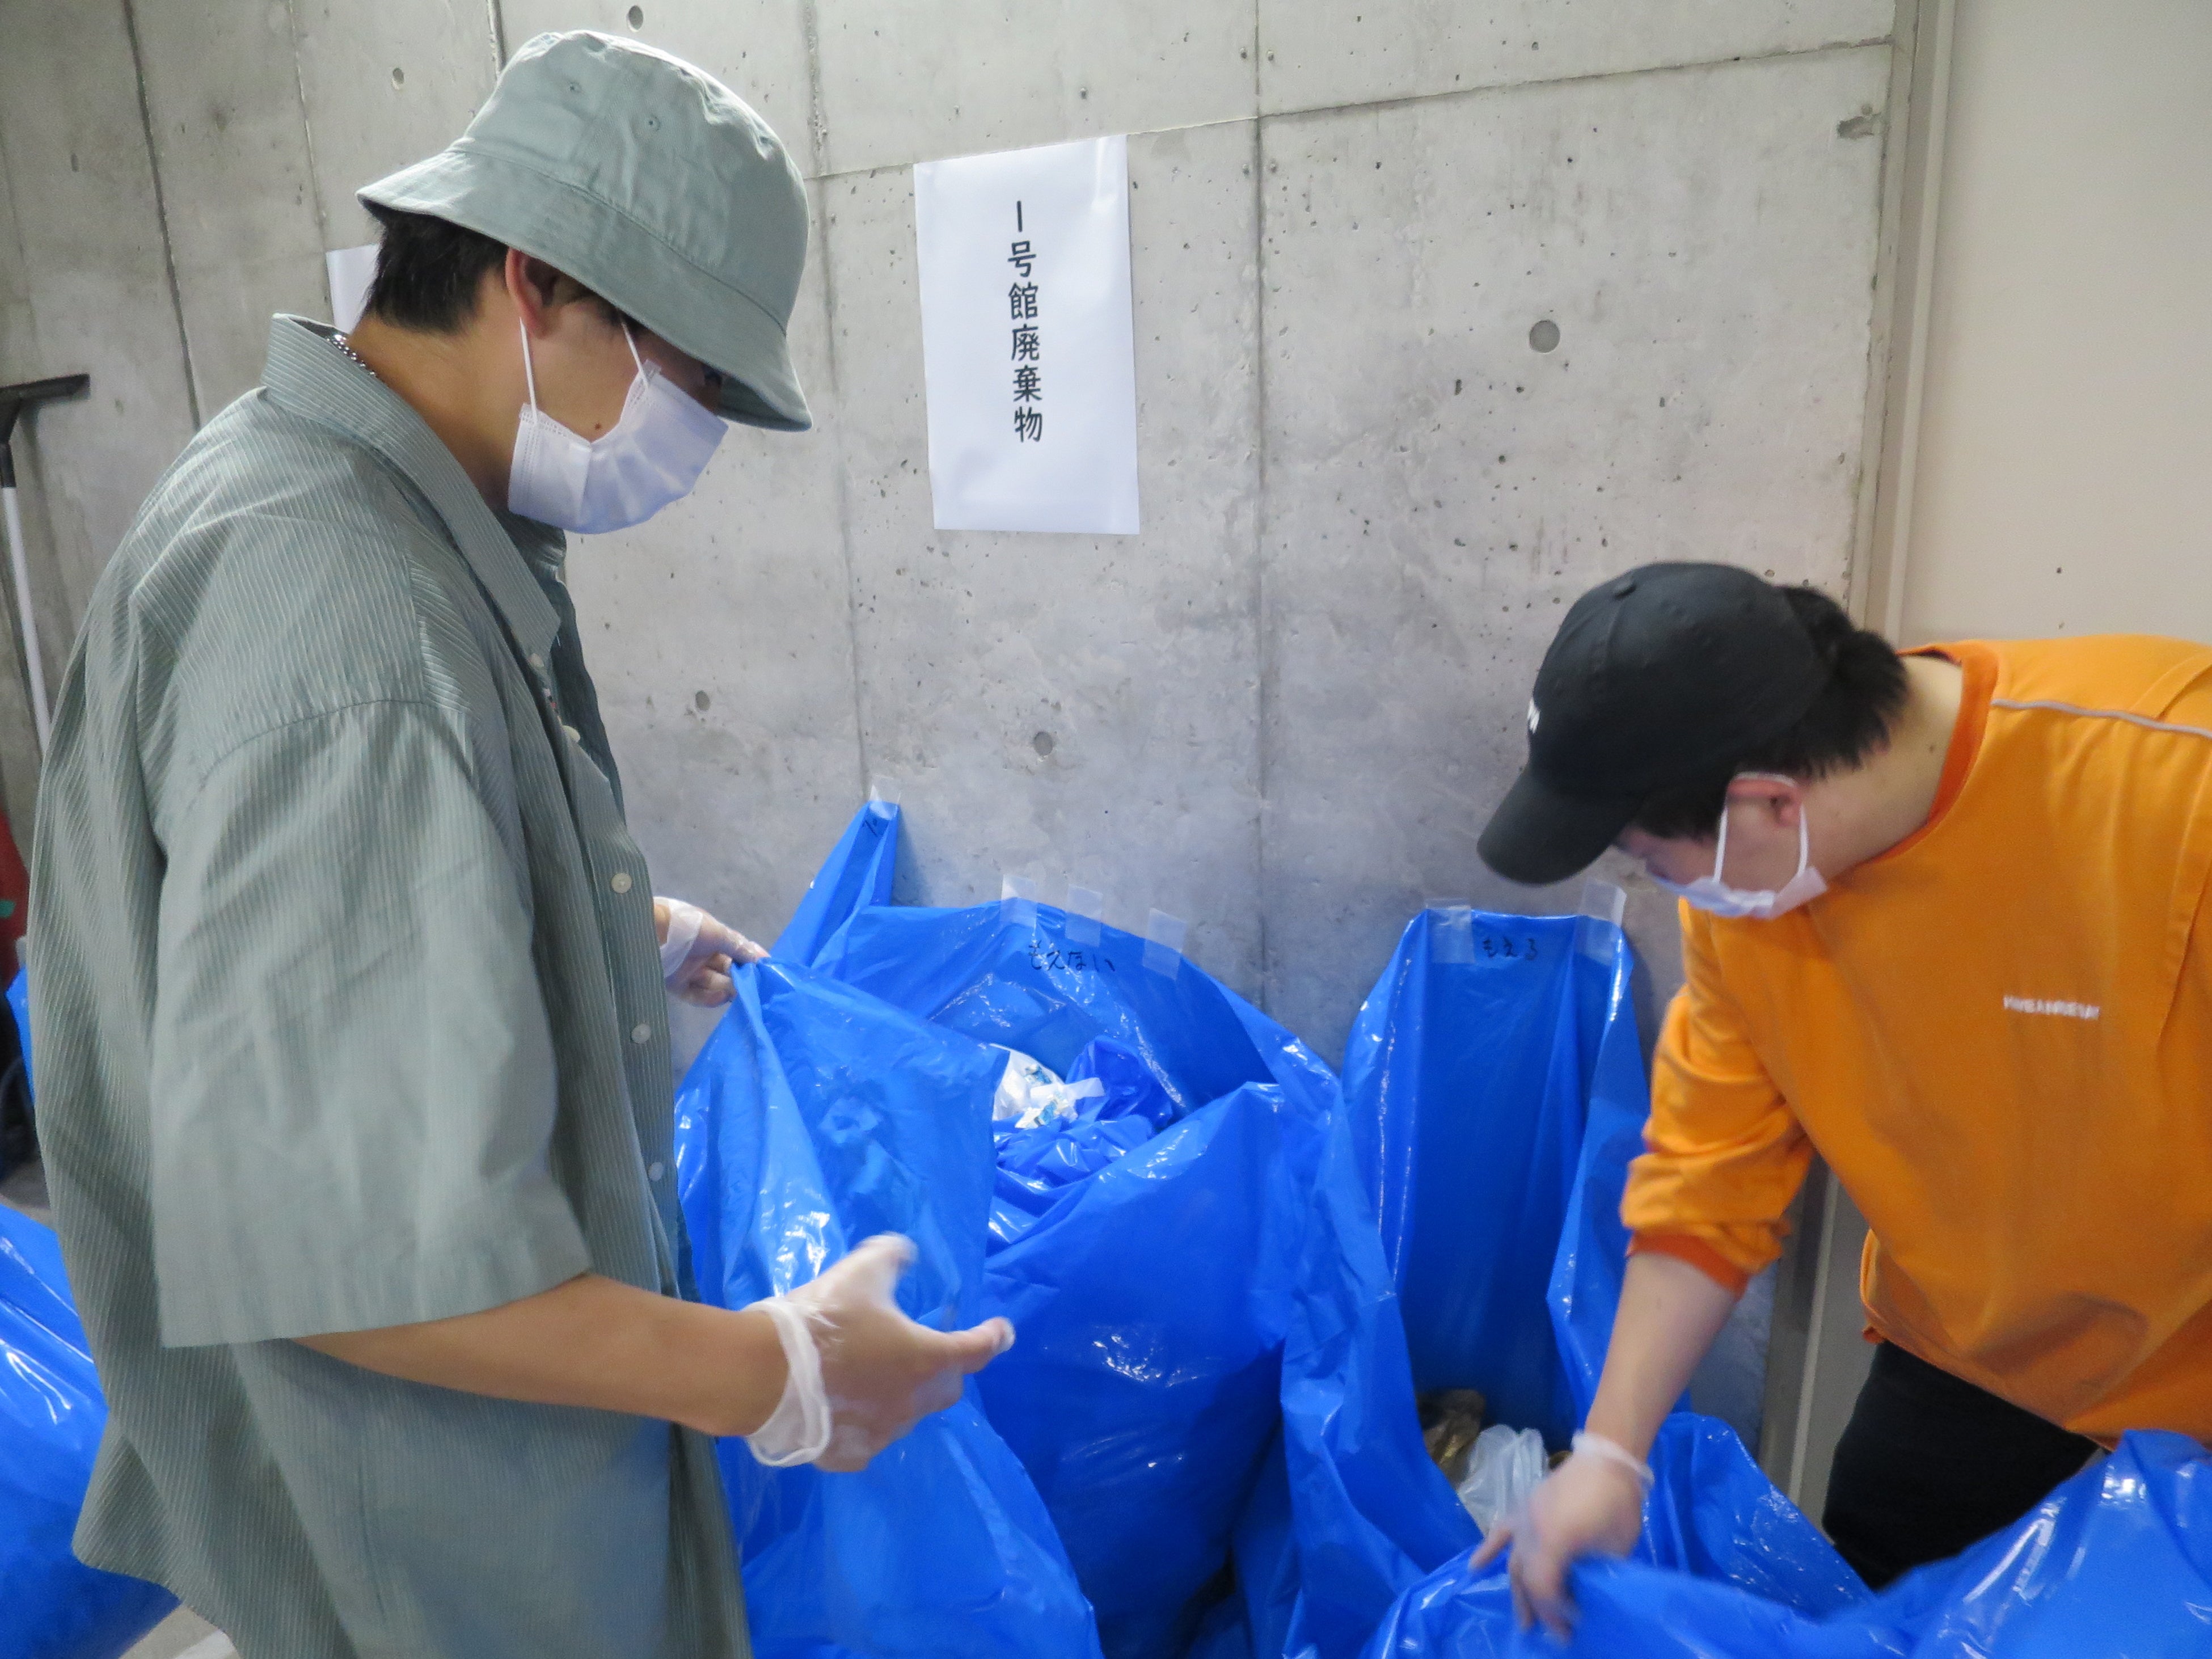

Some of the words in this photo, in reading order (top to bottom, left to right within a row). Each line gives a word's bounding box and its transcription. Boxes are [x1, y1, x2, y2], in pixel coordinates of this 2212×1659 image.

[1028, 940, 1116, 972] もえない
[1482, 937, 1538, 961] もえる
